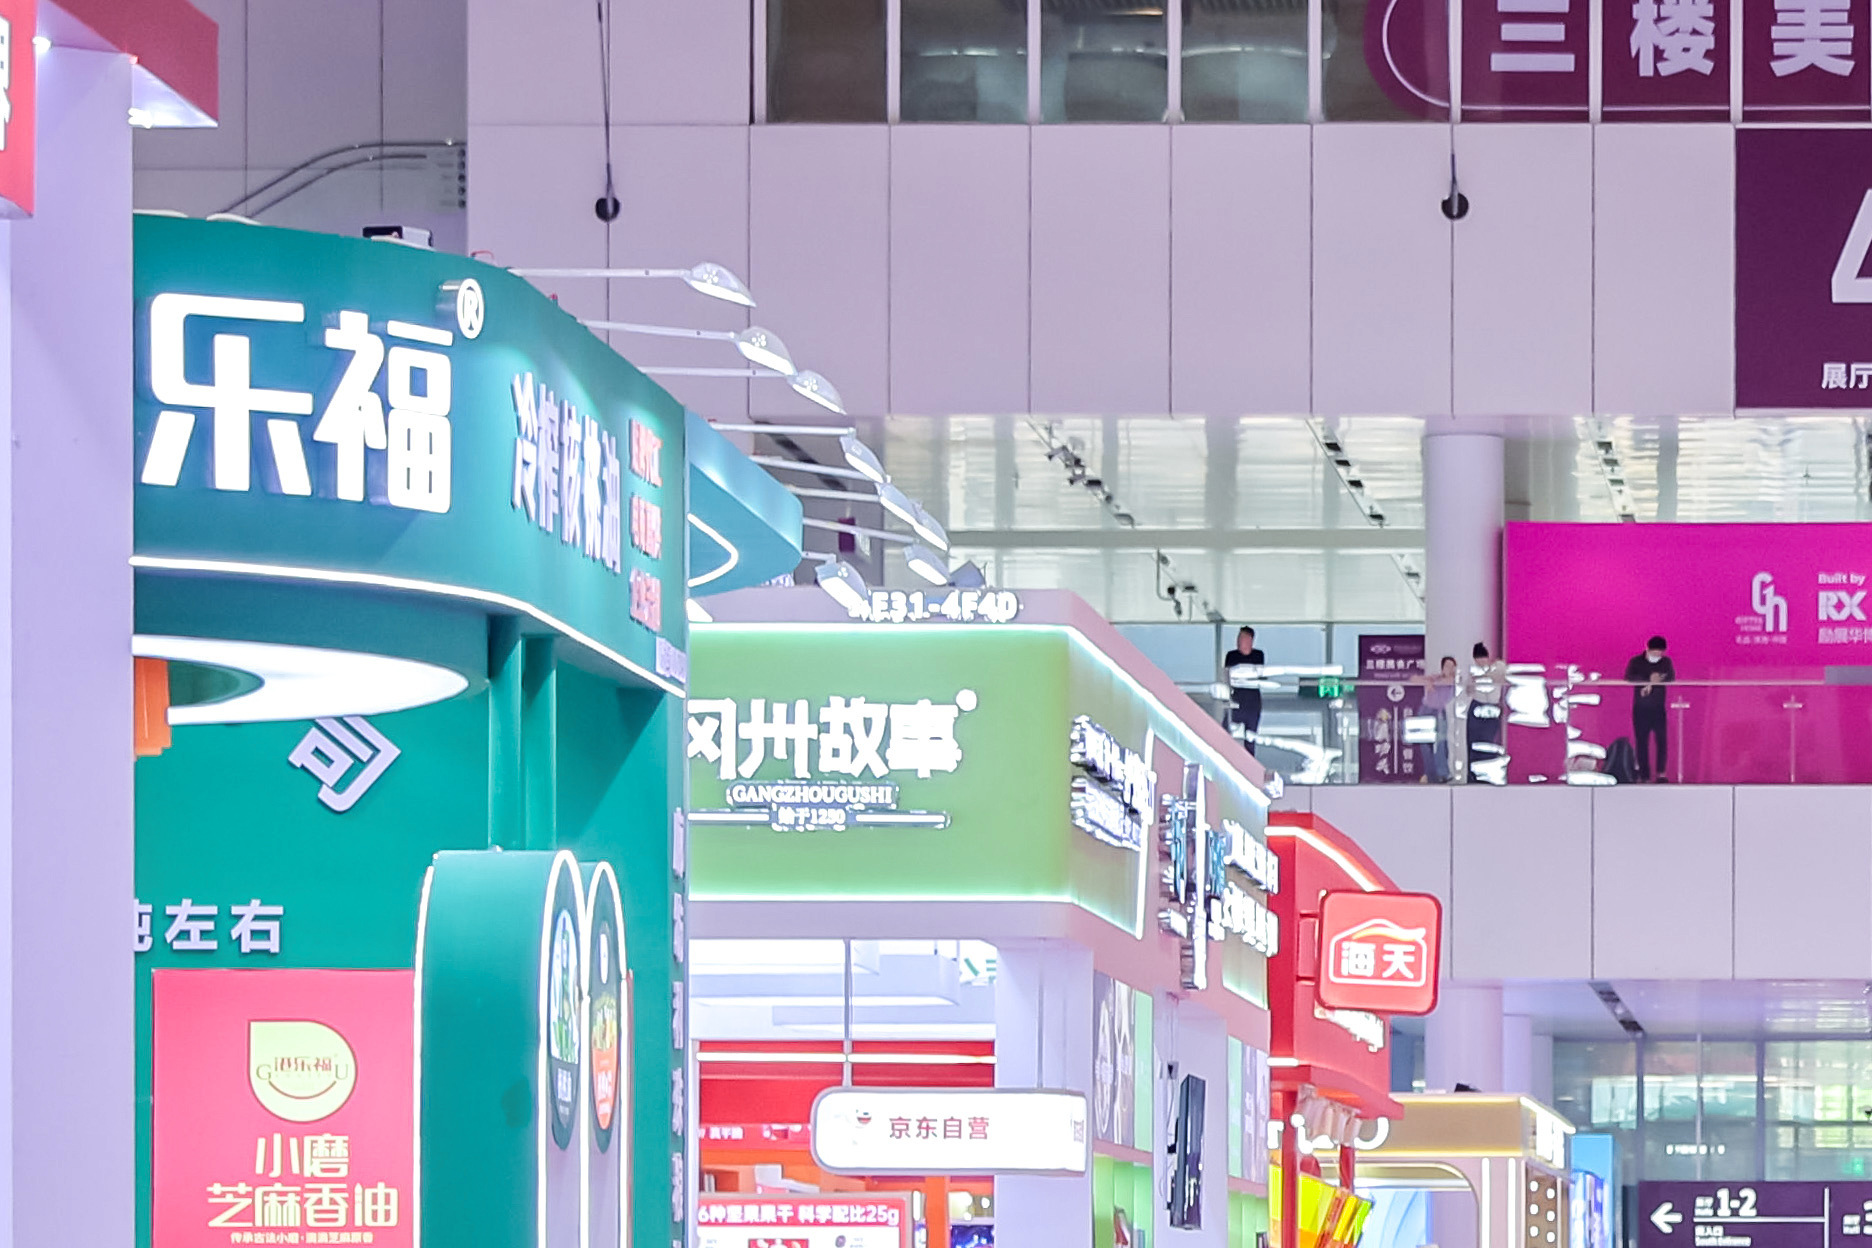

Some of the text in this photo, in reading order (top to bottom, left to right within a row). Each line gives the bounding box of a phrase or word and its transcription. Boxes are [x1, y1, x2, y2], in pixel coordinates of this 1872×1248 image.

[1818, 573, 1865, 586] Built by
[855, 590, 1018, 623] E31-4F40
[1818, 591, 1867, 621] RX
[732, 786, 892, 804] GANGZHOUGUSHI
[1341, 942, 1416, 979] 海天
[889, 1116, 990, 1140] 京东自营
[255, 1133, 349, 1178] 小磨
[206, 1182, 399, 1228] 芝麻香油
[1717, 1188, 1757, 1217] 1-2
